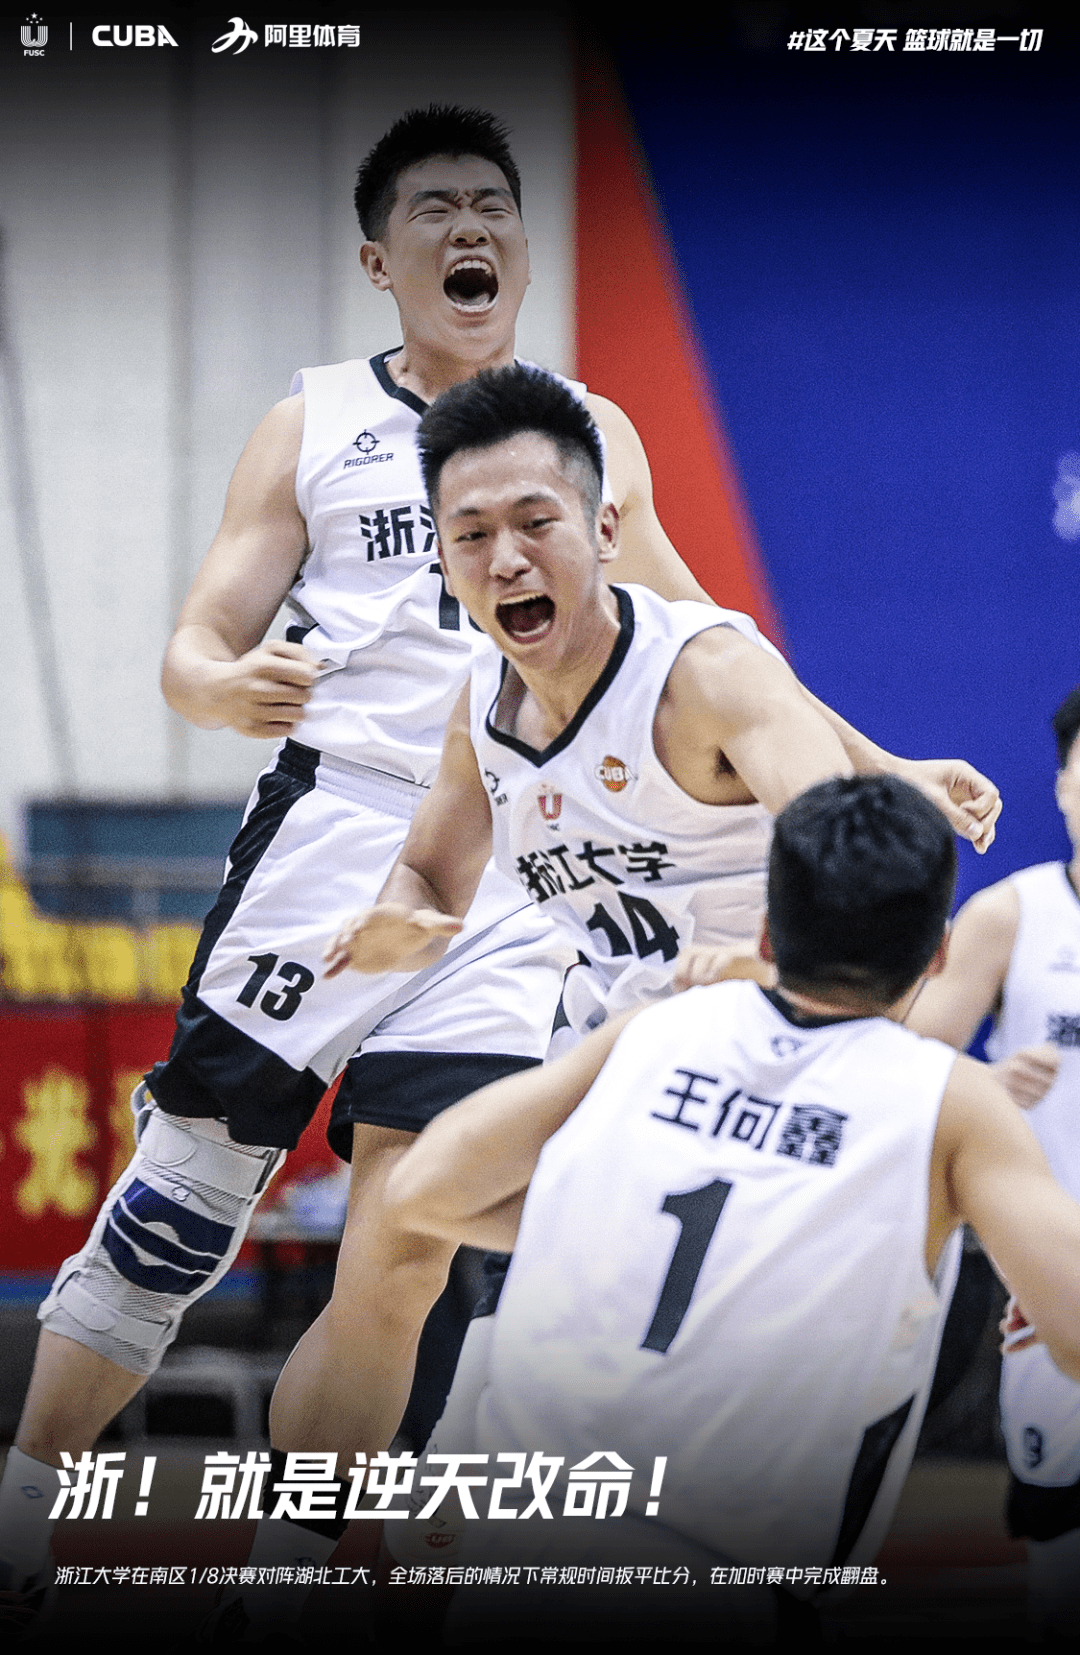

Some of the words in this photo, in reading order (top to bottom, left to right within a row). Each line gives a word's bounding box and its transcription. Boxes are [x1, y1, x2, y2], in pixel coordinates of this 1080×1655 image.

[343, 452, 394, 470] RIGORER
[586, 891, 680, 963] 14
[236, 952, 315, 1021] 13
[650, 1068, 849, 1168] 王何鑫
[640, 1177, 733, 1355] 1
